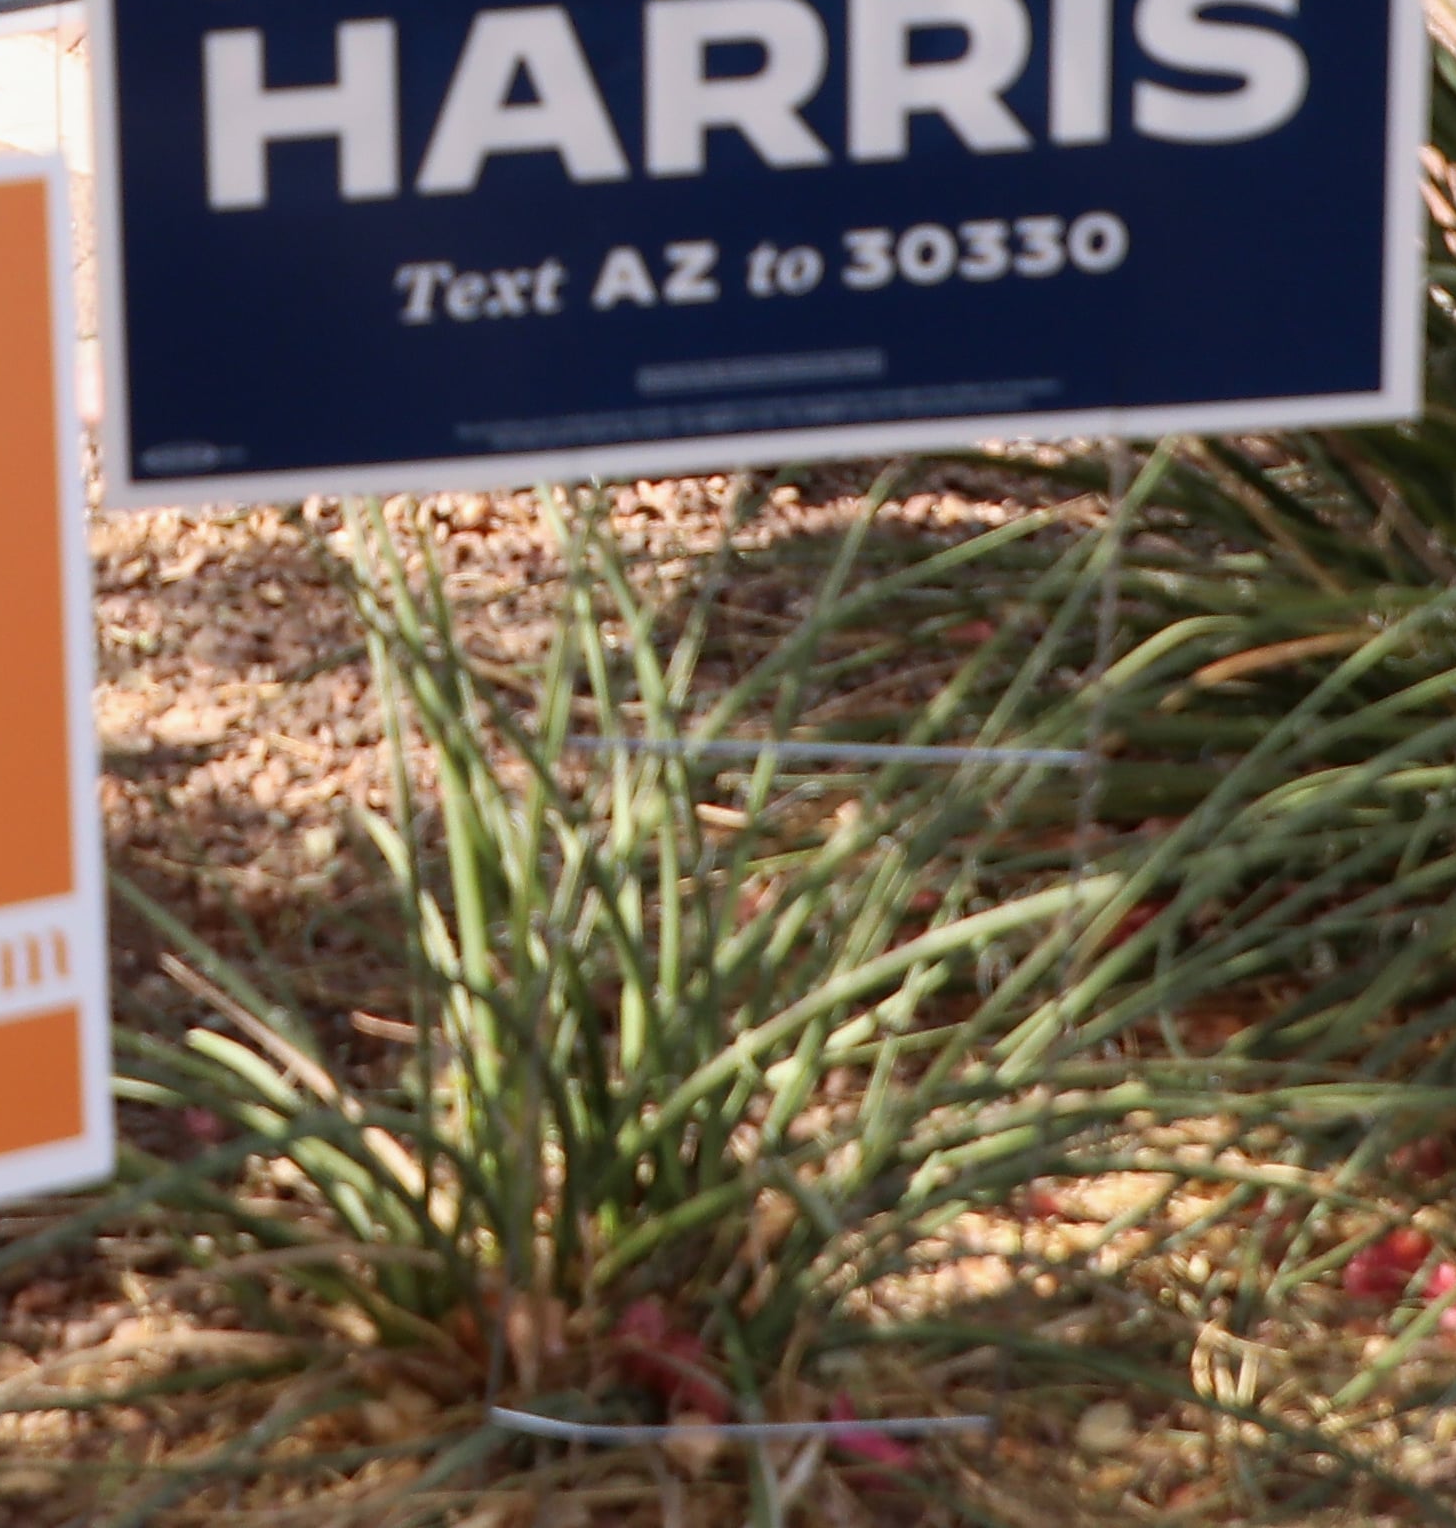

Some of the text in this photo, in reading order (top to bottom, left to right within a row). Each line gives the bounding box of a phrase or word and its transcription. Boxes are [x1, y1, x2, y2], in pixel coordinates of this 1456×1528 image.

[396, 211, 1133, 326] Text AZ to 30330
